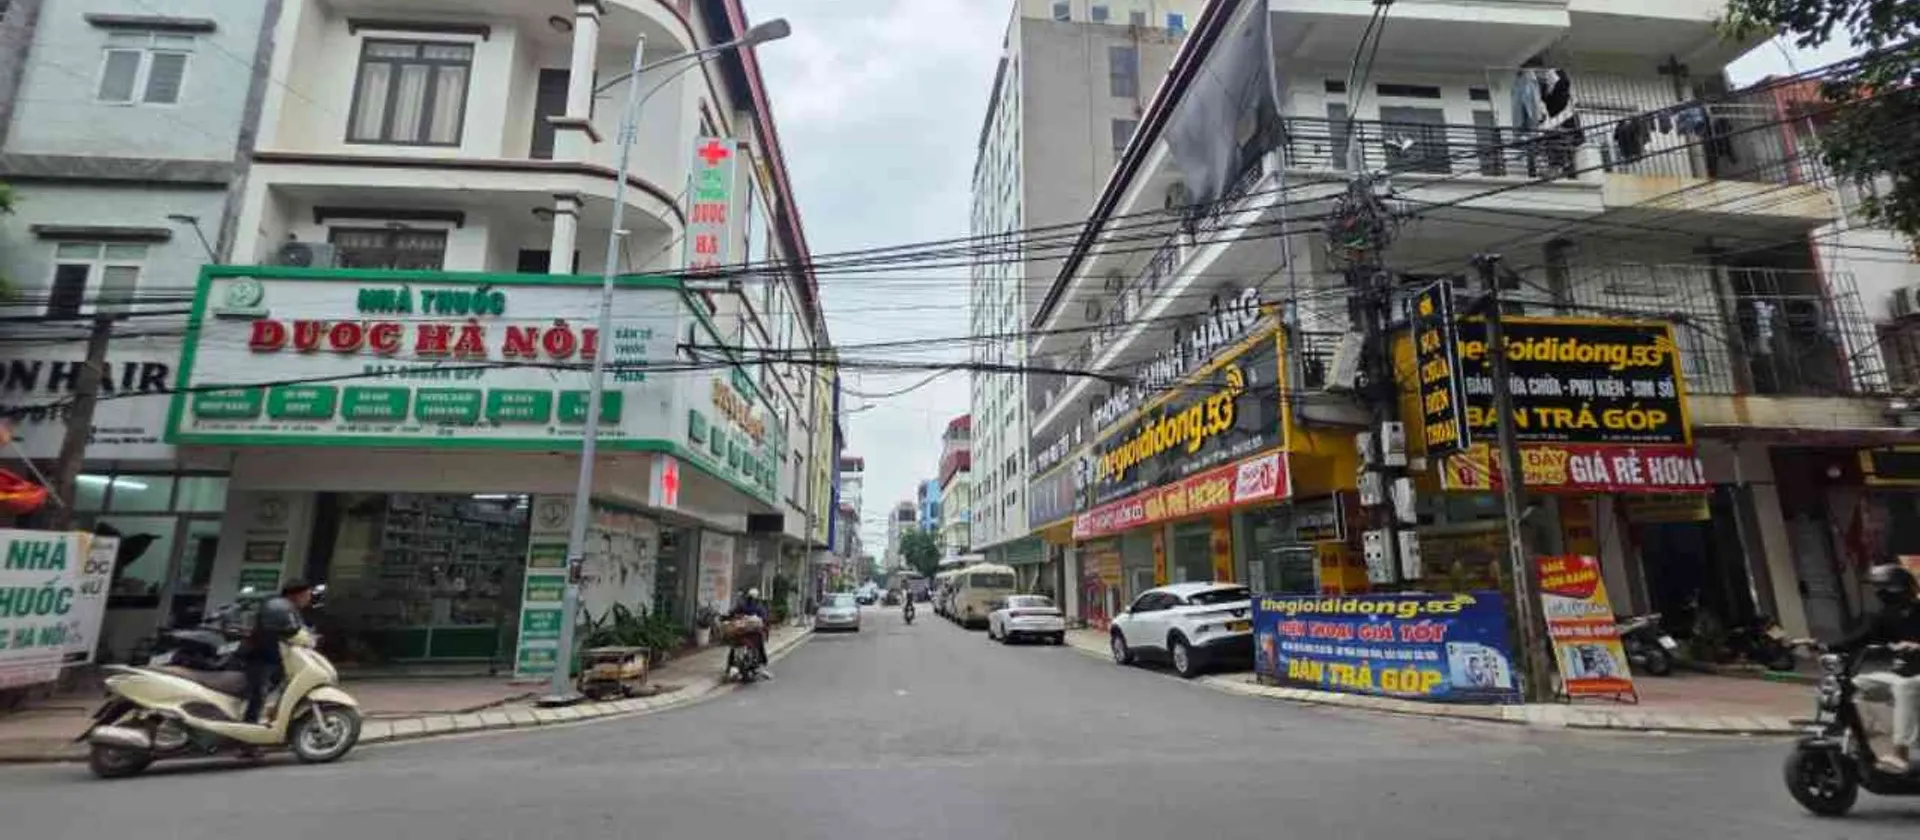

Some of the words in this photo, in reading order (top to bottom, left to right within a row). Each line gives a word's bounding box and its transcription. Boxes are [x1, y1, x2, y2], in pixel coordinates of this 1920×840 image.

[358, 285, 413, 314] NHÀ
[421, 284, 505, 315] THUỐC
[415, 318, 488, 357] HÀ
[1533, 398, 1597, 430] TRẢ
[1603, 402, 1667, 431] GÓP
[1569, 450, 1609, 484] GIÁ
[1612, 447, 1645, 484] RẺ
[4, 536, 67, 570] NHÀ
[0, 576, 74, 617] HUỐC
[1358, 621, 1394, 642] GIÁ
[1399, 619, 1448, 643] TỐT
[1289, 655, 1324, 681] BÁN
[1327, 659, 1373, 690] TRẢ
[1380, 665, 1442, 694] GÓP
